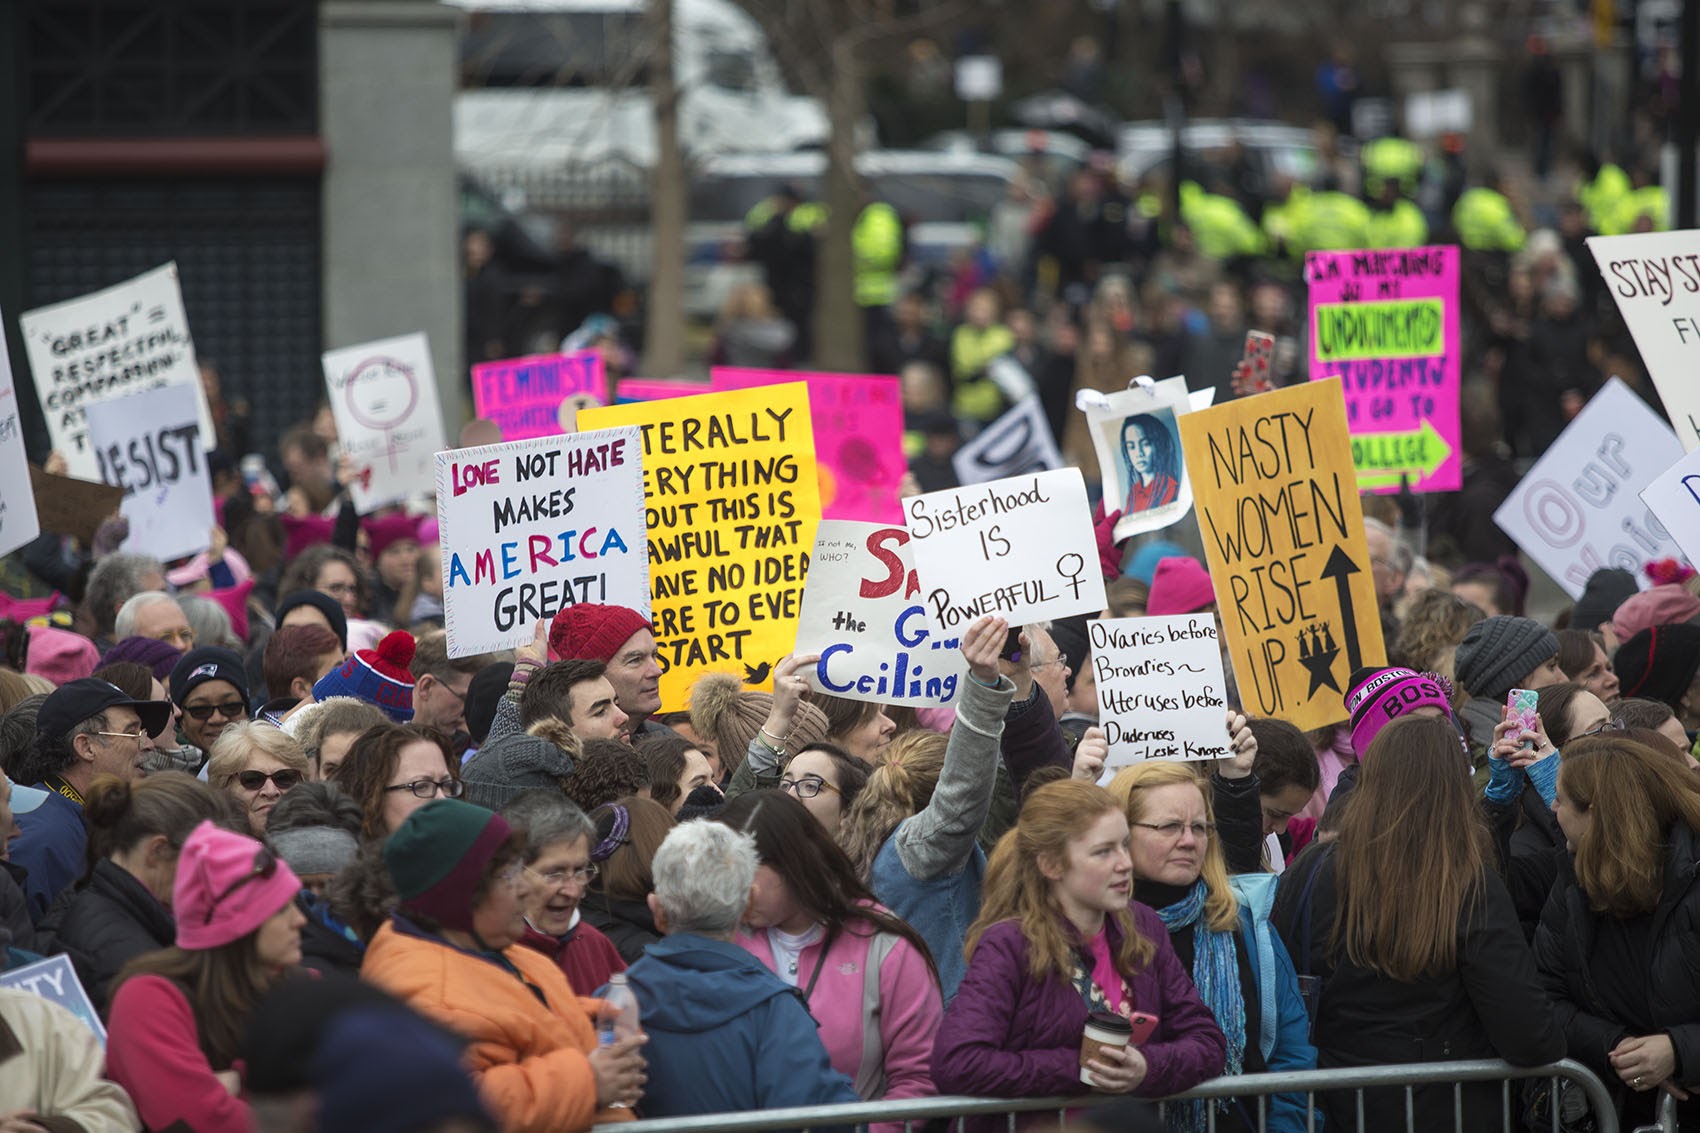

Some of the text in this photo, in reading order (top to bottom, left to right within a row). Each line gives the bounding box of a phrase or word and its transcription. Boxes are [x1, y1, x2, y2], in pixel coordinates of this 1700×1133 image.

[1609, 256, 1674, 306] STAY
[482, 357, 596, 405] FEMINIST
[451, 438, 626, 497] LOVE NOT HATE
[1208, 407, 1314, 489] NASTY
[493, 487, 576, 534] MAKES
[706, 492, 760, 523] THIS
[768, 490, 795, 518] IS
[911, 478, 1050, 539] Sisterhood
[1523, 432, 1632, 549] Our
[1205, 472, 1348, 564] WOMEN
[449, 527, 628, 587] AMERICA
[647, 520, 803, 564] AWFUL THAT
[819, 553, 849, 563] WHO?
[979, 525, 1011, 560] IS
[707, 563, 745, 593] NO
[754, 552, 810, 586] IDEA
[1230, 553, 1317, 636] RISE
[494, 573, 606, 632] GREAT!
[703, 600, 740, 629] TO
[750, 588, 804, 621] EVE
[832, 611, 866, 633] the
[655, 629, 752, 674] START
[1091, 619, 1218, 649] Ovaries before
[817, 643, 958, 703] Ceiling
[1182, 685, 1223, 709] before
[1382, 683, 1440, 719] BOS
[1103, 721, 1175, 746] Duderuses
[1183, 741, 1230, 758] Knope
